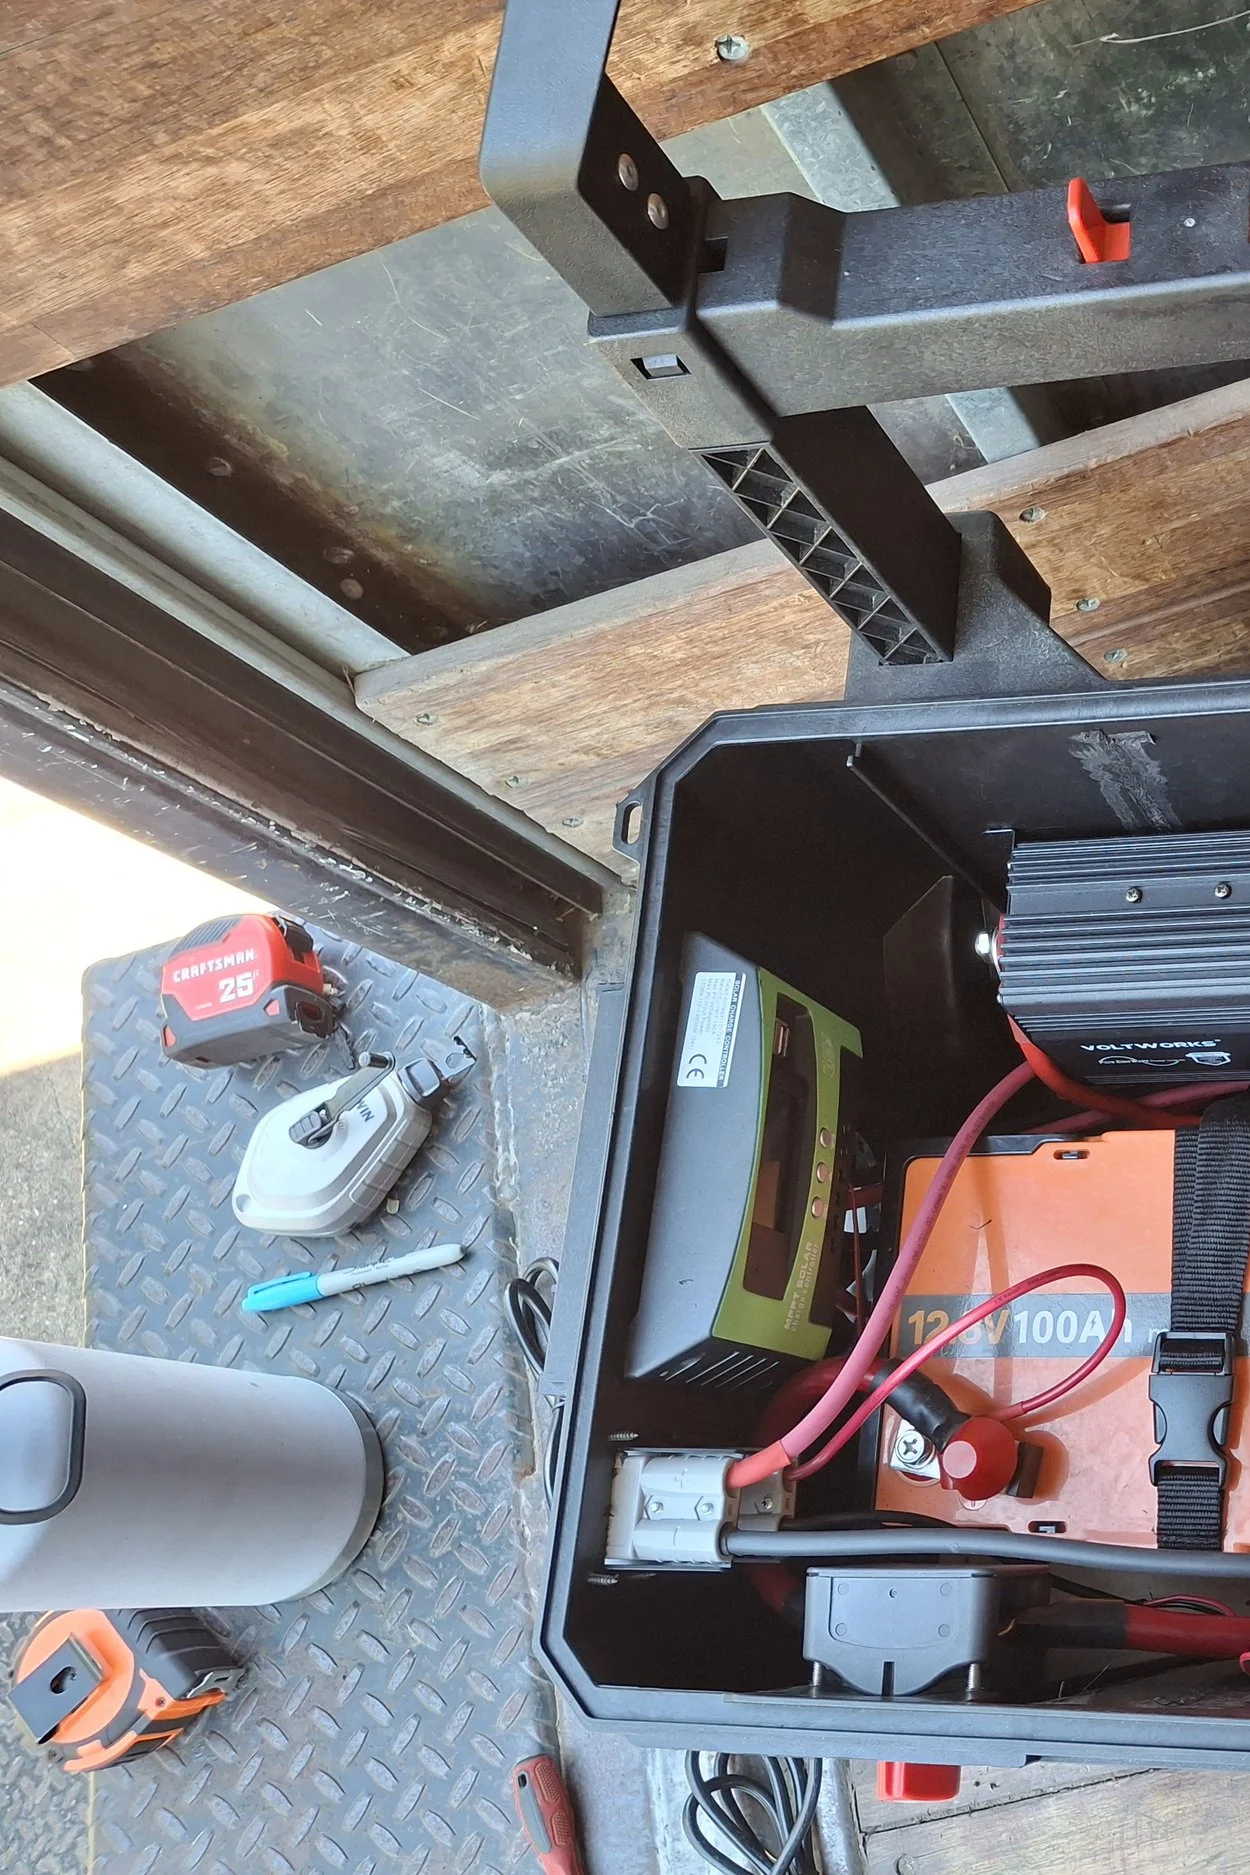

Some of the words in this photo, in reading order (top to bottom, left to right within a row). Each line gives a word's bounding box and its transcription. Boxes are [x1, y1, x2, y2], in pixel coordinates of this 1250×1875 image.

[173, 948, 256, 983] CRAFTSMAN
[218, 971, 253, 1003] 25
[732, 980, 741, 1002] SOLAR
[726, 1004, 736, 1031] CHARGE
[718, 1035, 731, 1081] CONTROLLER
[1080, 1040, 1217, 1051] VOLTWORKS
